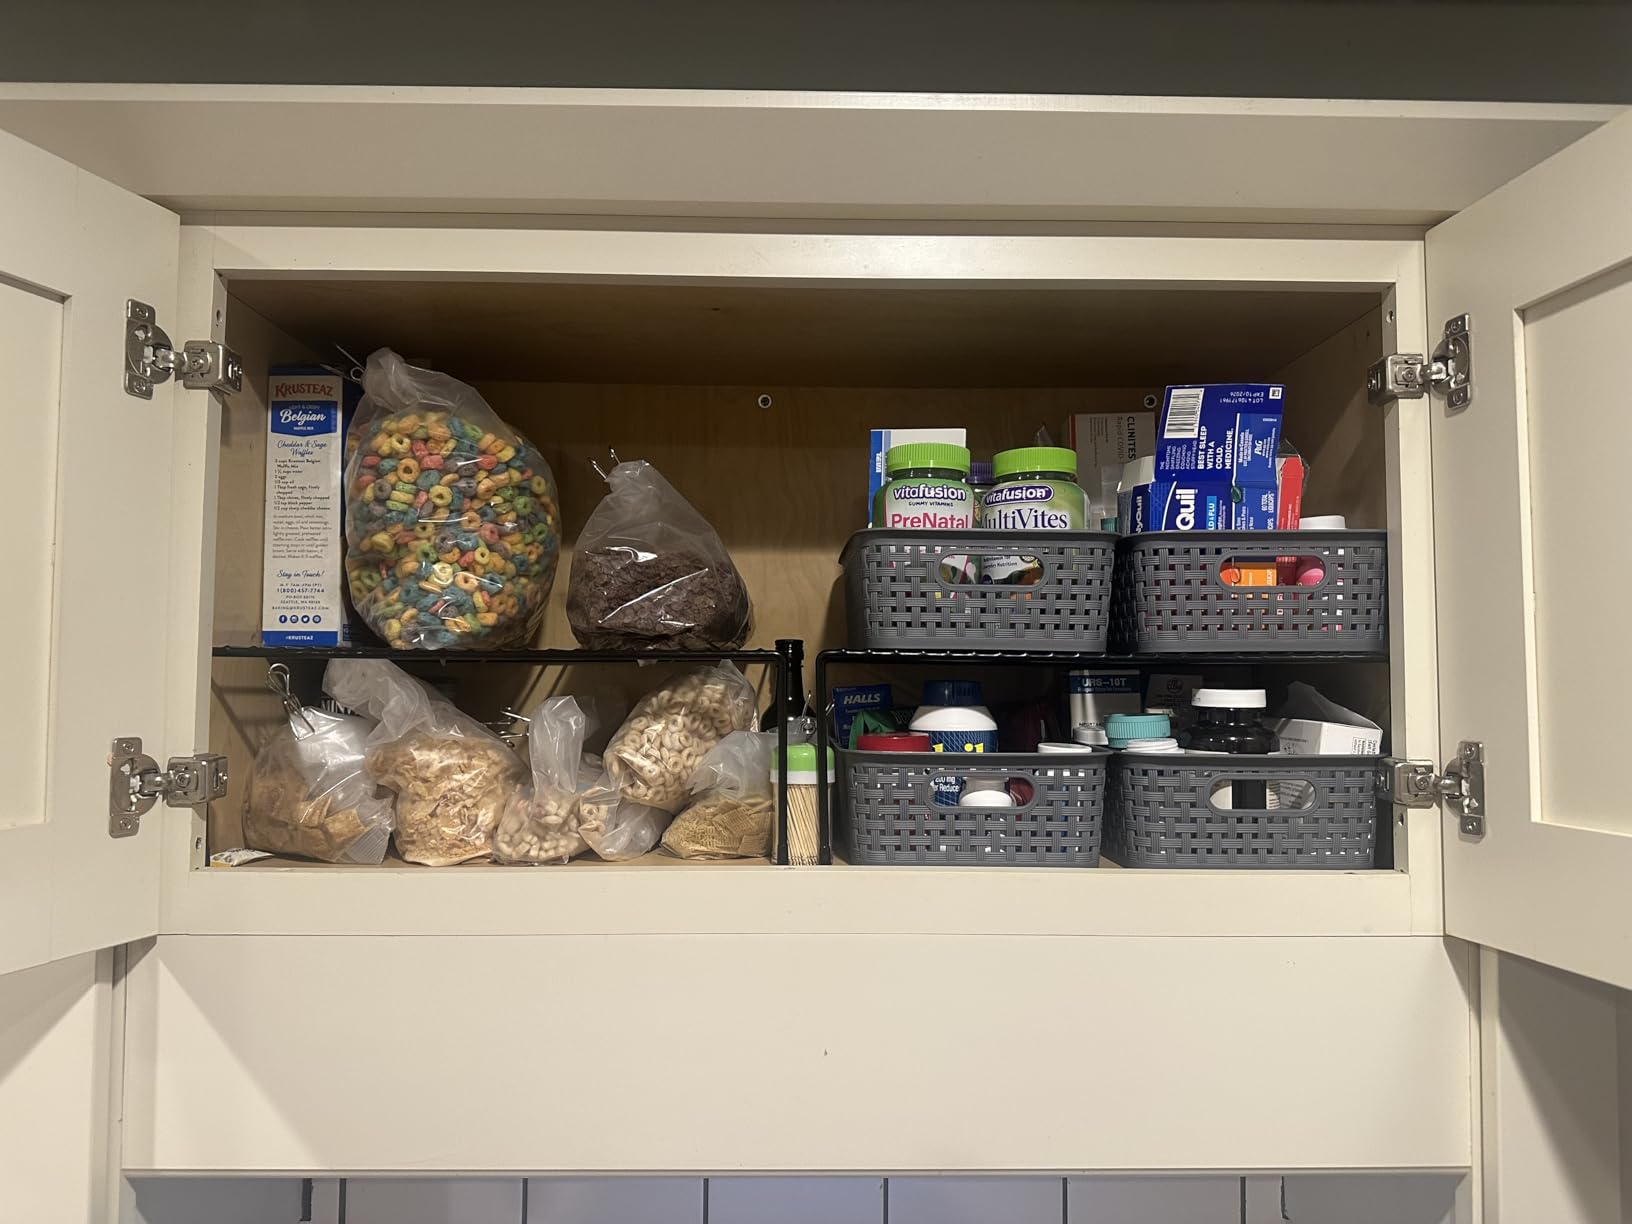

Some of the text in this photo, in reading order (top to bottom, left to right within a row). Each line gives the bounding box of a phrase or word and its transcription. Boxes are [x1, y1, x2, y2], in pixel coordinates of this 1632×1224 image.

[275, 383, 334, 398] KRUSTEAZ
[280, 409, 326, 426] Belgian
[278, 440, 303, 448] Cheddar
[311, 440, 327, 449] Sage
[1128, 416, 1136, 460] CLINITES
[1199, 426, 1207, 449] SLEEP
[291, 448, 313, 457] Waffles
[1225, 428, 1233, 469] MEDICINE.
[1254, 440, 1262, 455] P&G
[894, 484, 966, 500] vitafusion
[986, 487, 1046, 503] vitafusion
[892, 512, 968, 528] PreNatal
[277, 570, 292, 579] Stay
[844, 693, 881, 705] HALLS
